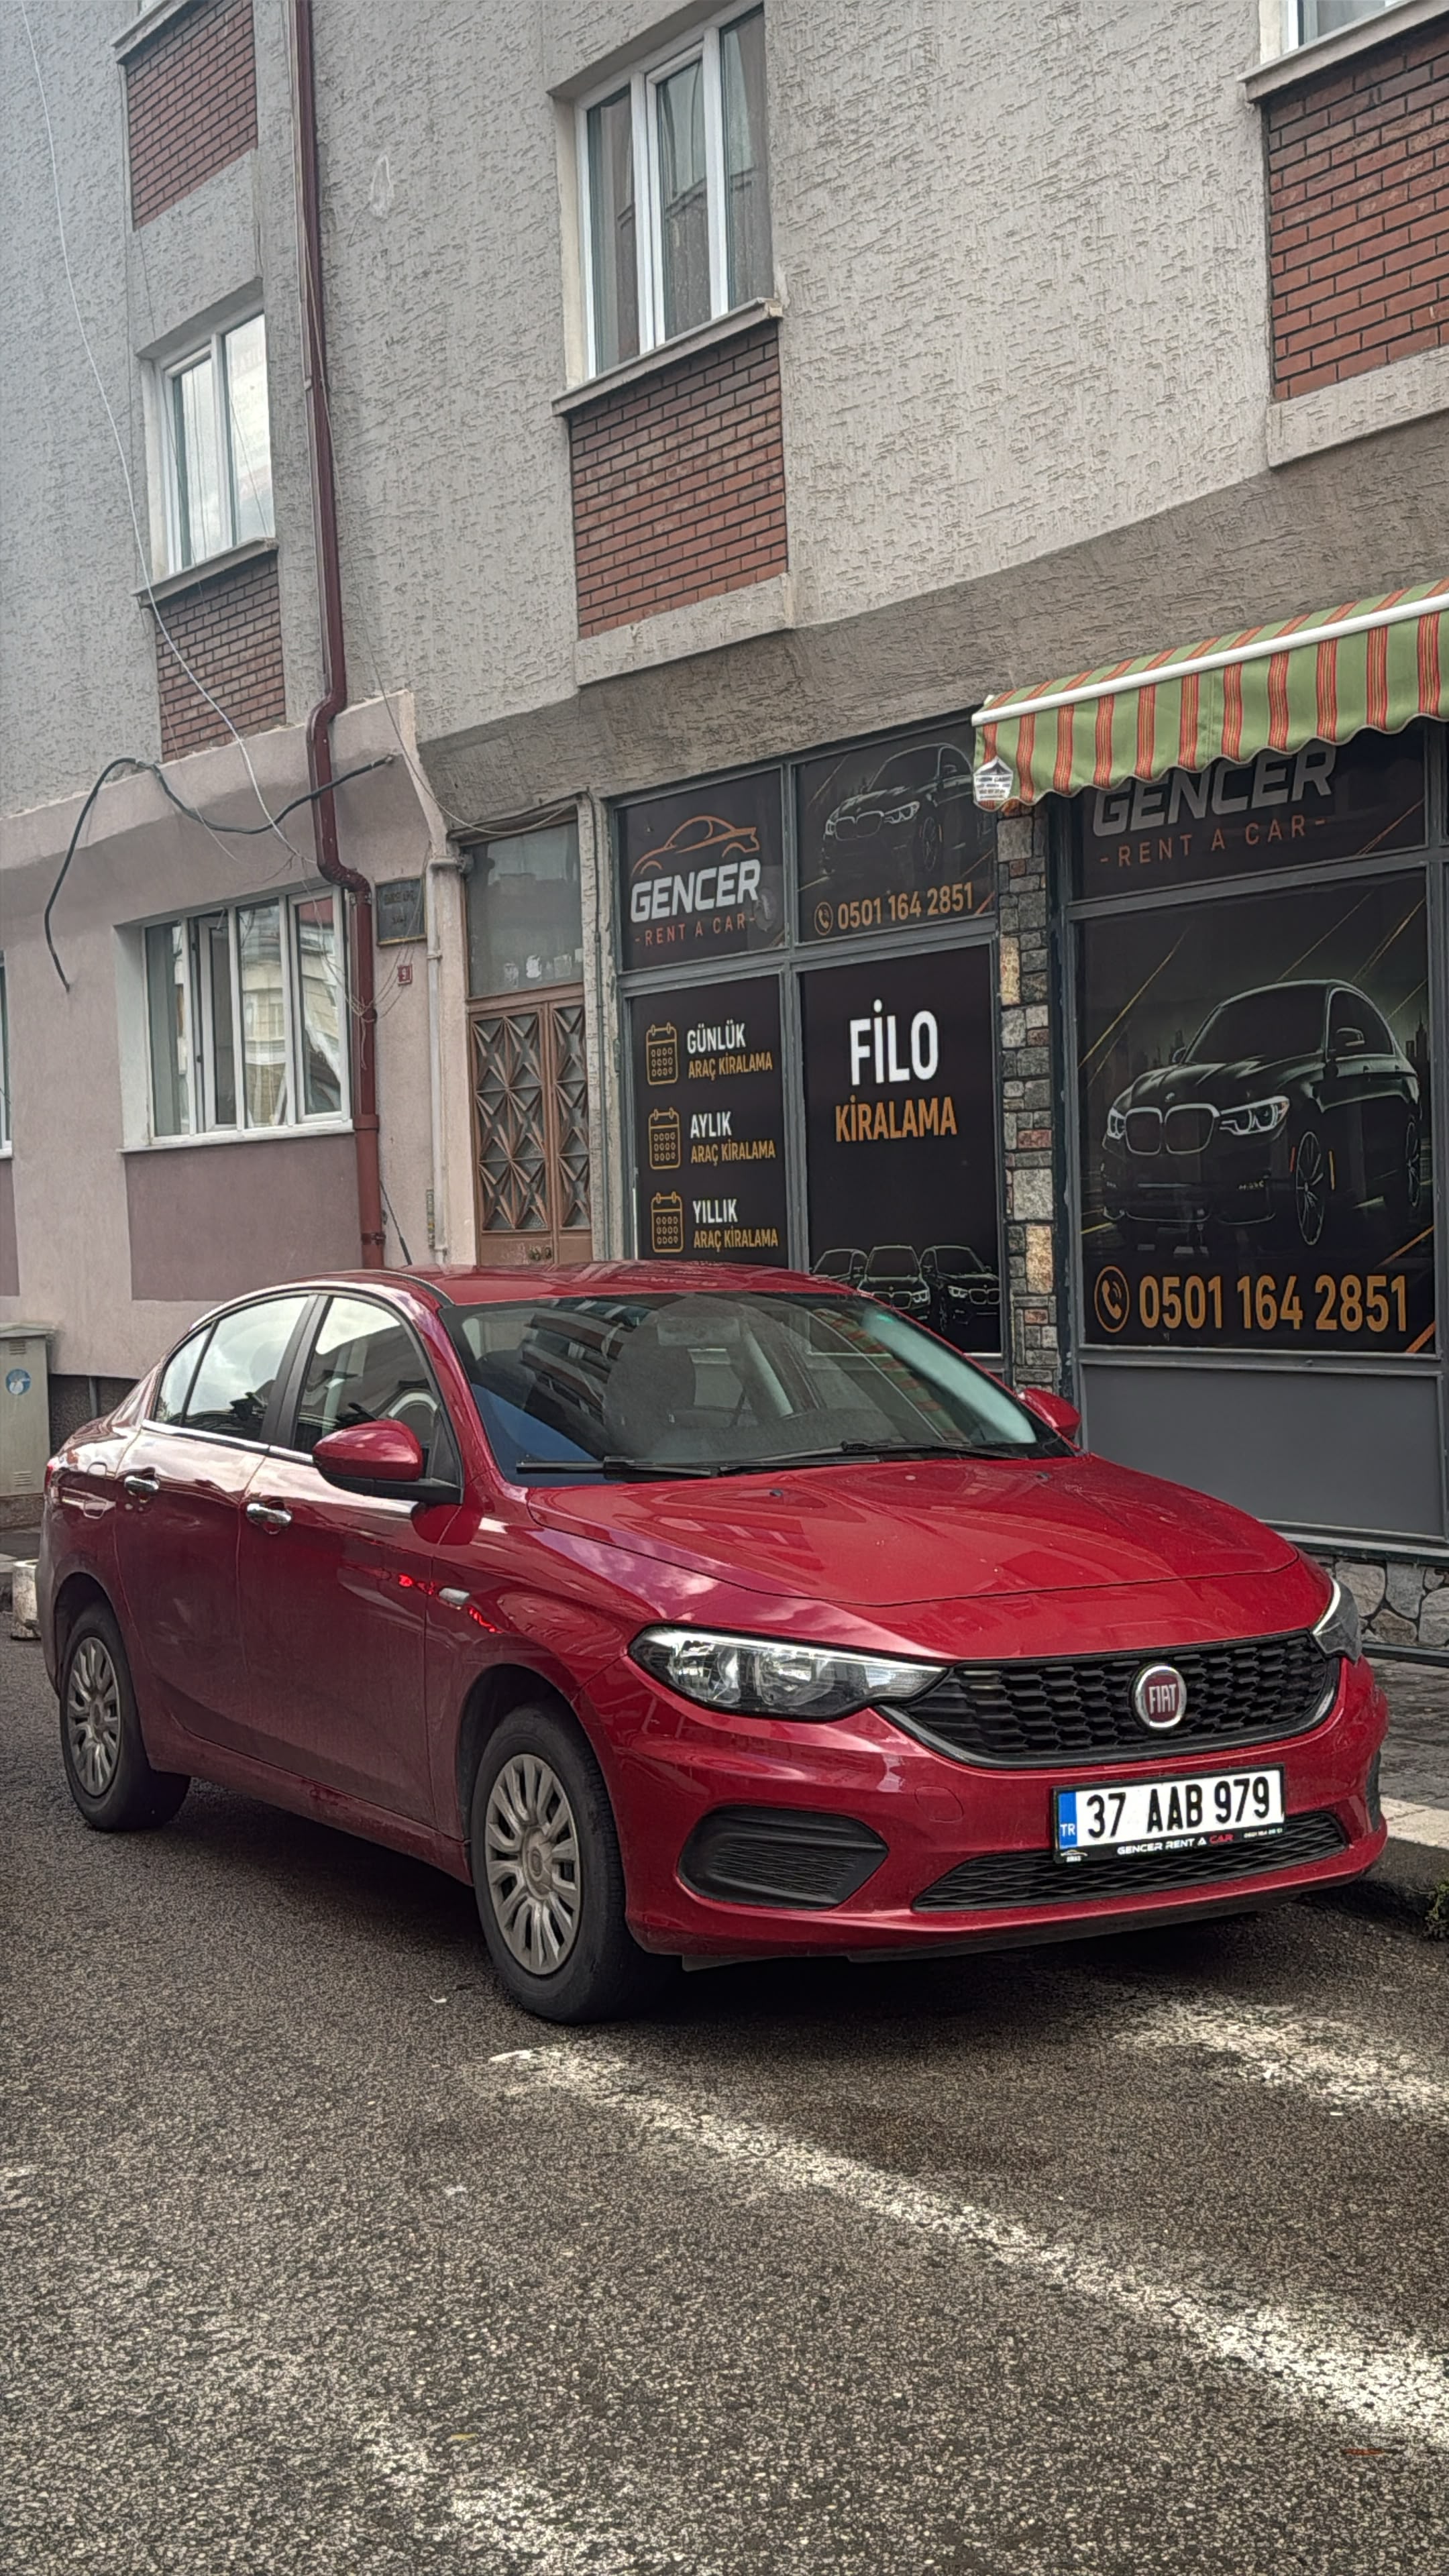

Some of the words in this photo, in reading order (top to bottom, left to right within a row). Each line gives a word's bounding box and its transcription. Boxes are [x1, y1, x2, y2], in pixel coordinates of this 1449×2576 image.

[1093, 741, 1336, 837] GENCER
[1211, 828, 1225, 851] A
[631, 859, 761, 922] GENCER
[838, 899, 881, 930] 0501
[888, 892, 922, 922] 164
[926, 882, 973, 917] 2851
[695, 920, 703, 937] A
[687, 1019, 746, 1054] GÜNLÜK
[850, 999, 938, 1085] FİLO
[688, 1057, 716, 1081] ARAÇ
[716, 1052, 773, 1078] KİRALAMA
[690, 1111, 732, 1139] AYLIK
[835, 1095, 957, 1142] KİRALAMA
[691, 1143, 718, 1166] ARAÇ
[720, 1139, 775, 1162] KİRALAMA
[692, 1199, 738, 1225] YILLIK
[694, 1230, 721, 1252] ARAÇ
[723, 1226, 778, 1248] KİRALAMA
[1140, 1275, 1222, 1330] 0501
[1237, 1275, 1303, 1331] 164
[1315, 1274, 1407, 1332] 2851
[1148, 1682, 1177, 1714] FIAT
[1087, 1792, 1126, 1839] 37
[1146, 1783, 1203, 1833] AAB
[1214, 1776, 1270, 1824] 979
[1060, 1823, 1075, 1837] TR
[1117, 1842, 1163, 1855] GENCER
[1165, 1837, 1195, 1850] RENT
[1197, 1837, 1207, 1846] A
[1210, 1833, 1234, 1844] CAR
